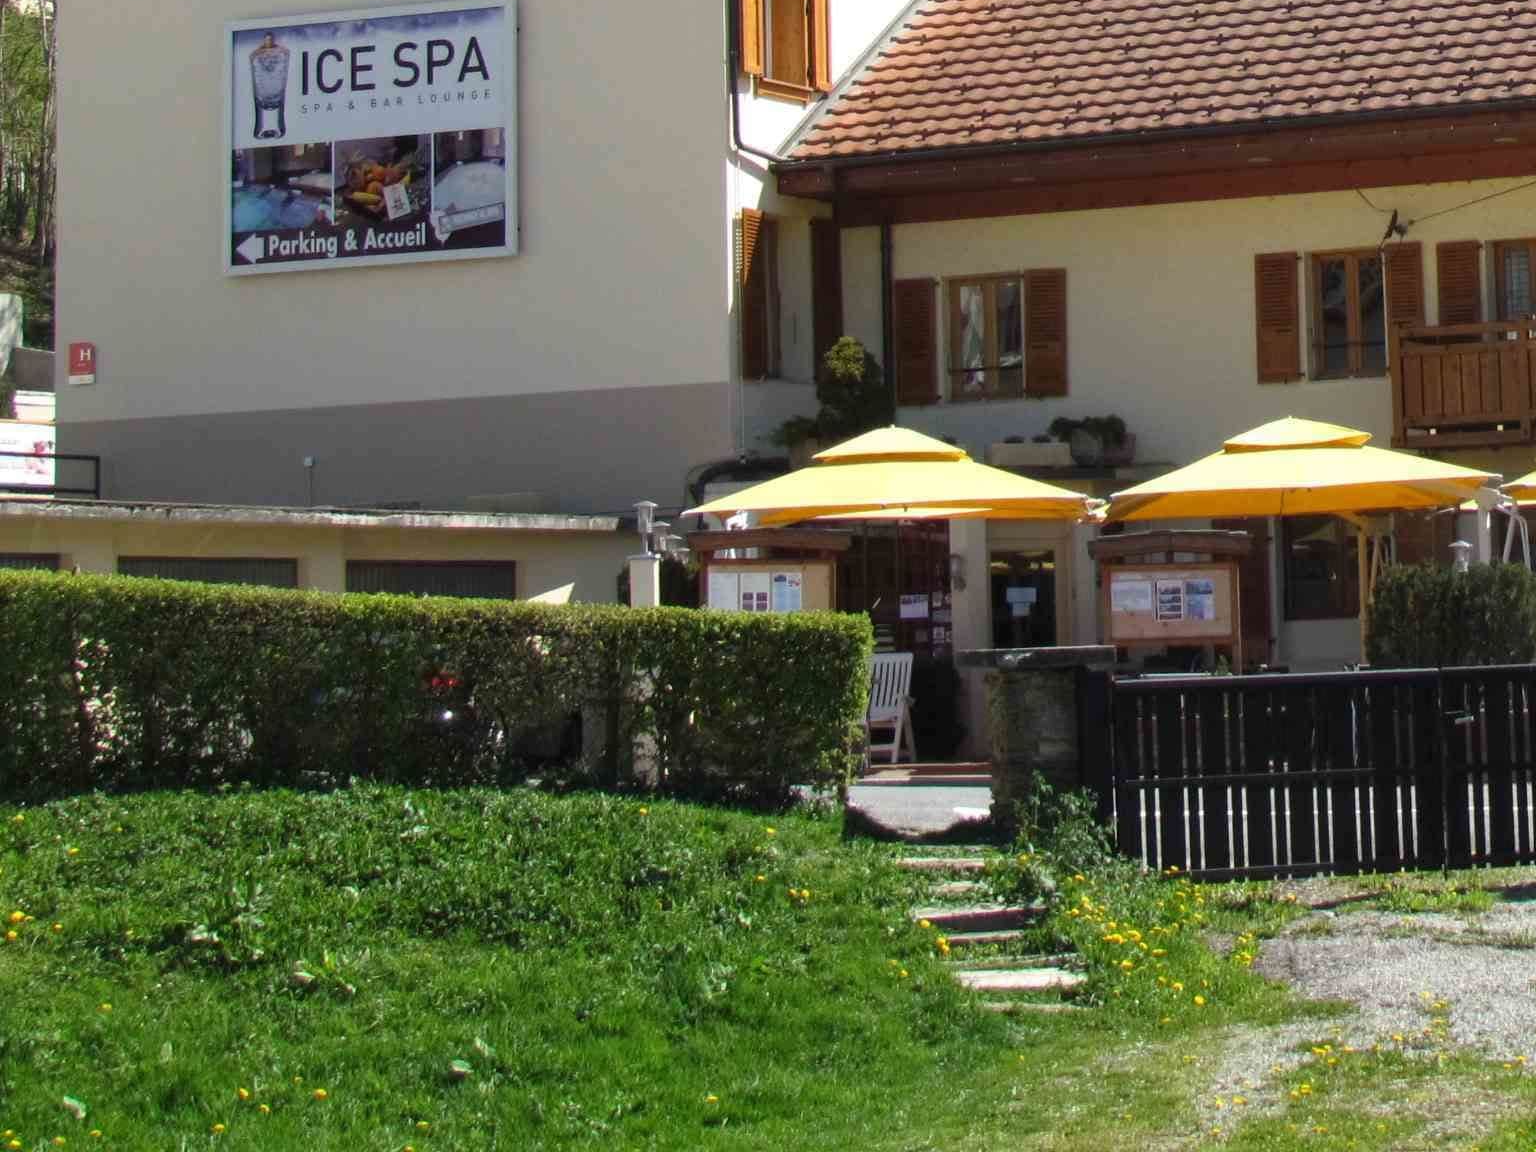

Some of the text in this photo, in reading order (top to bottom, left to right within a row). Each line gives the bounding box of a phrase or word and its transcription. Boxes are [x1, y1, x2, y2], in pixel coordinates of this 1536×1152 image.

[302, 36, 490, 96] ICE SPA
[301, 103, 334, 115] SPA
[370, 96, 403, 109] BAR
[418, 89, 491, 105] LOUNGE
[269, 223, 426, 258] Parking & Accueil
[80, 348, 91, 361] H
